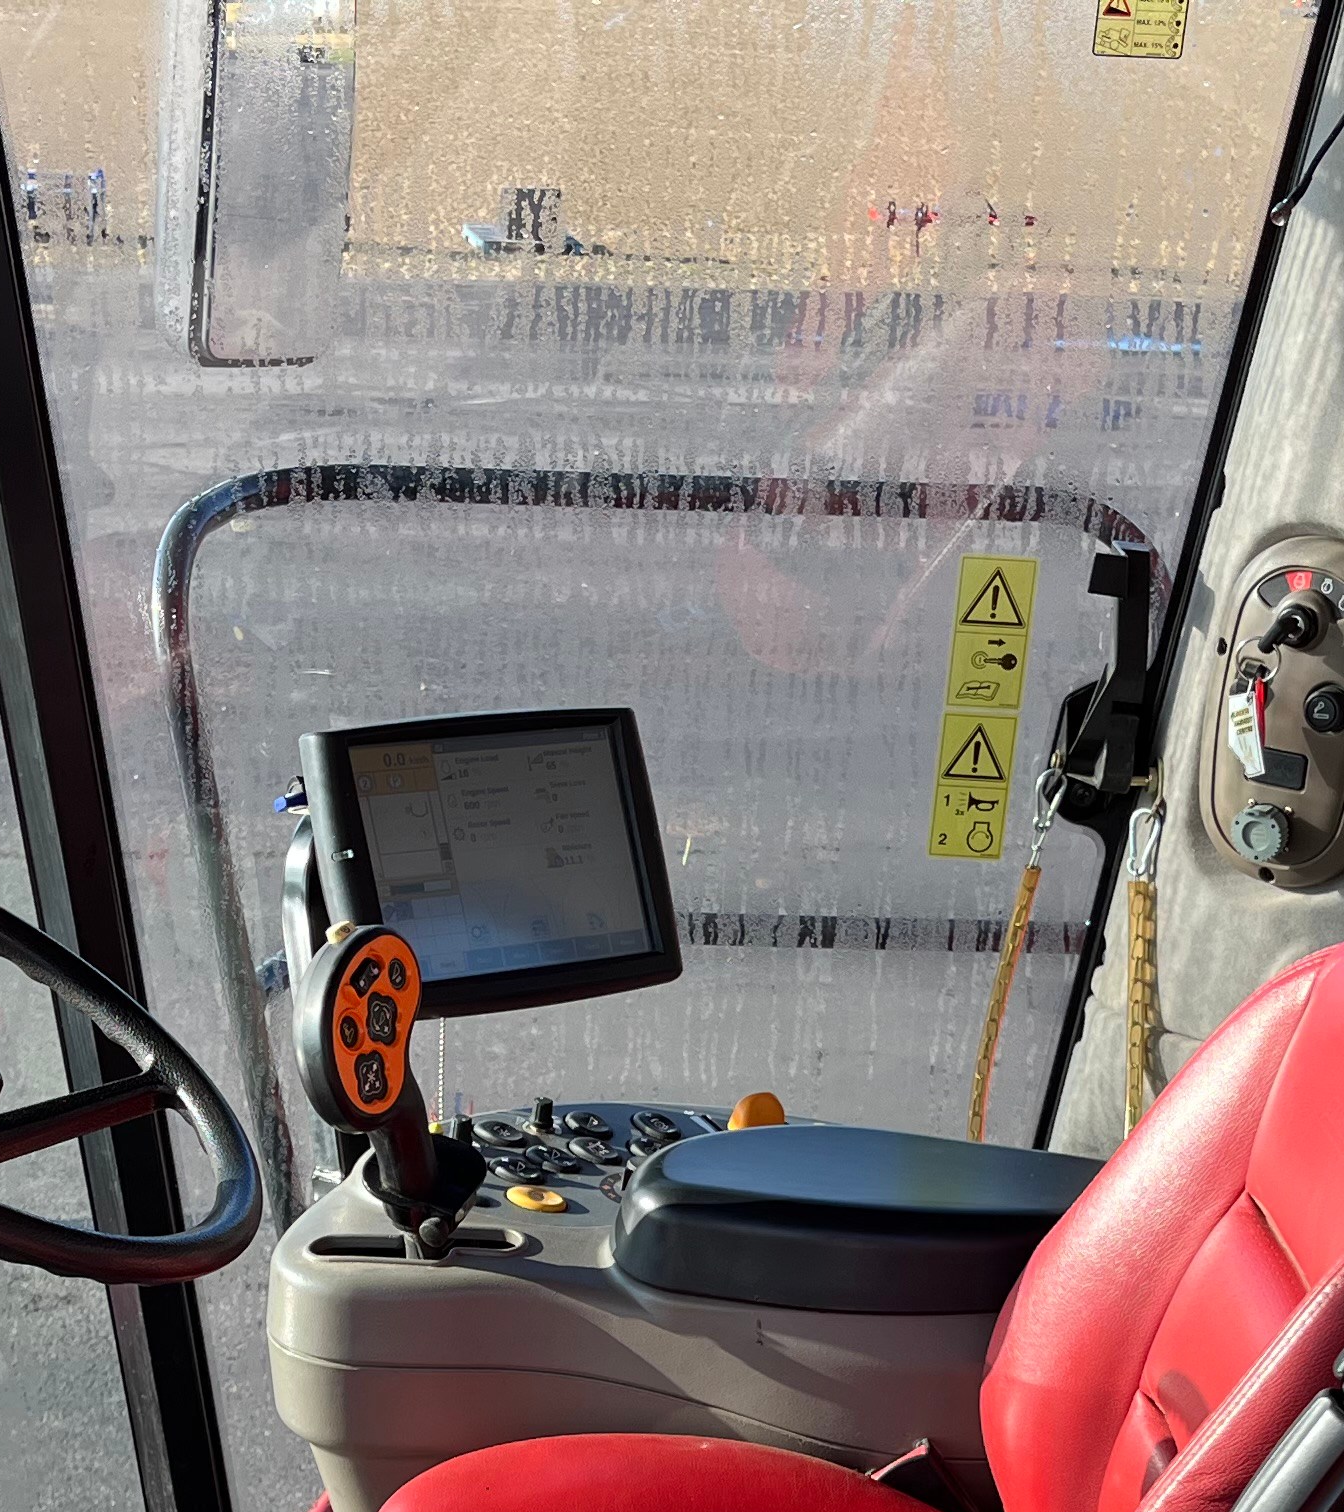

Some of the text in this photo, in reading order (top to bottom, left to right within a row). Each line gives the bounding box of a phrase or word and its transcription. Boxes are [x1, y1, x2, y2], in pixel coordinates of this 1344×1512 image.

[383, 752, 406, 768] 0.0
[943, 794, 951, 807] 1
[938, 833, 948, 846] 2
